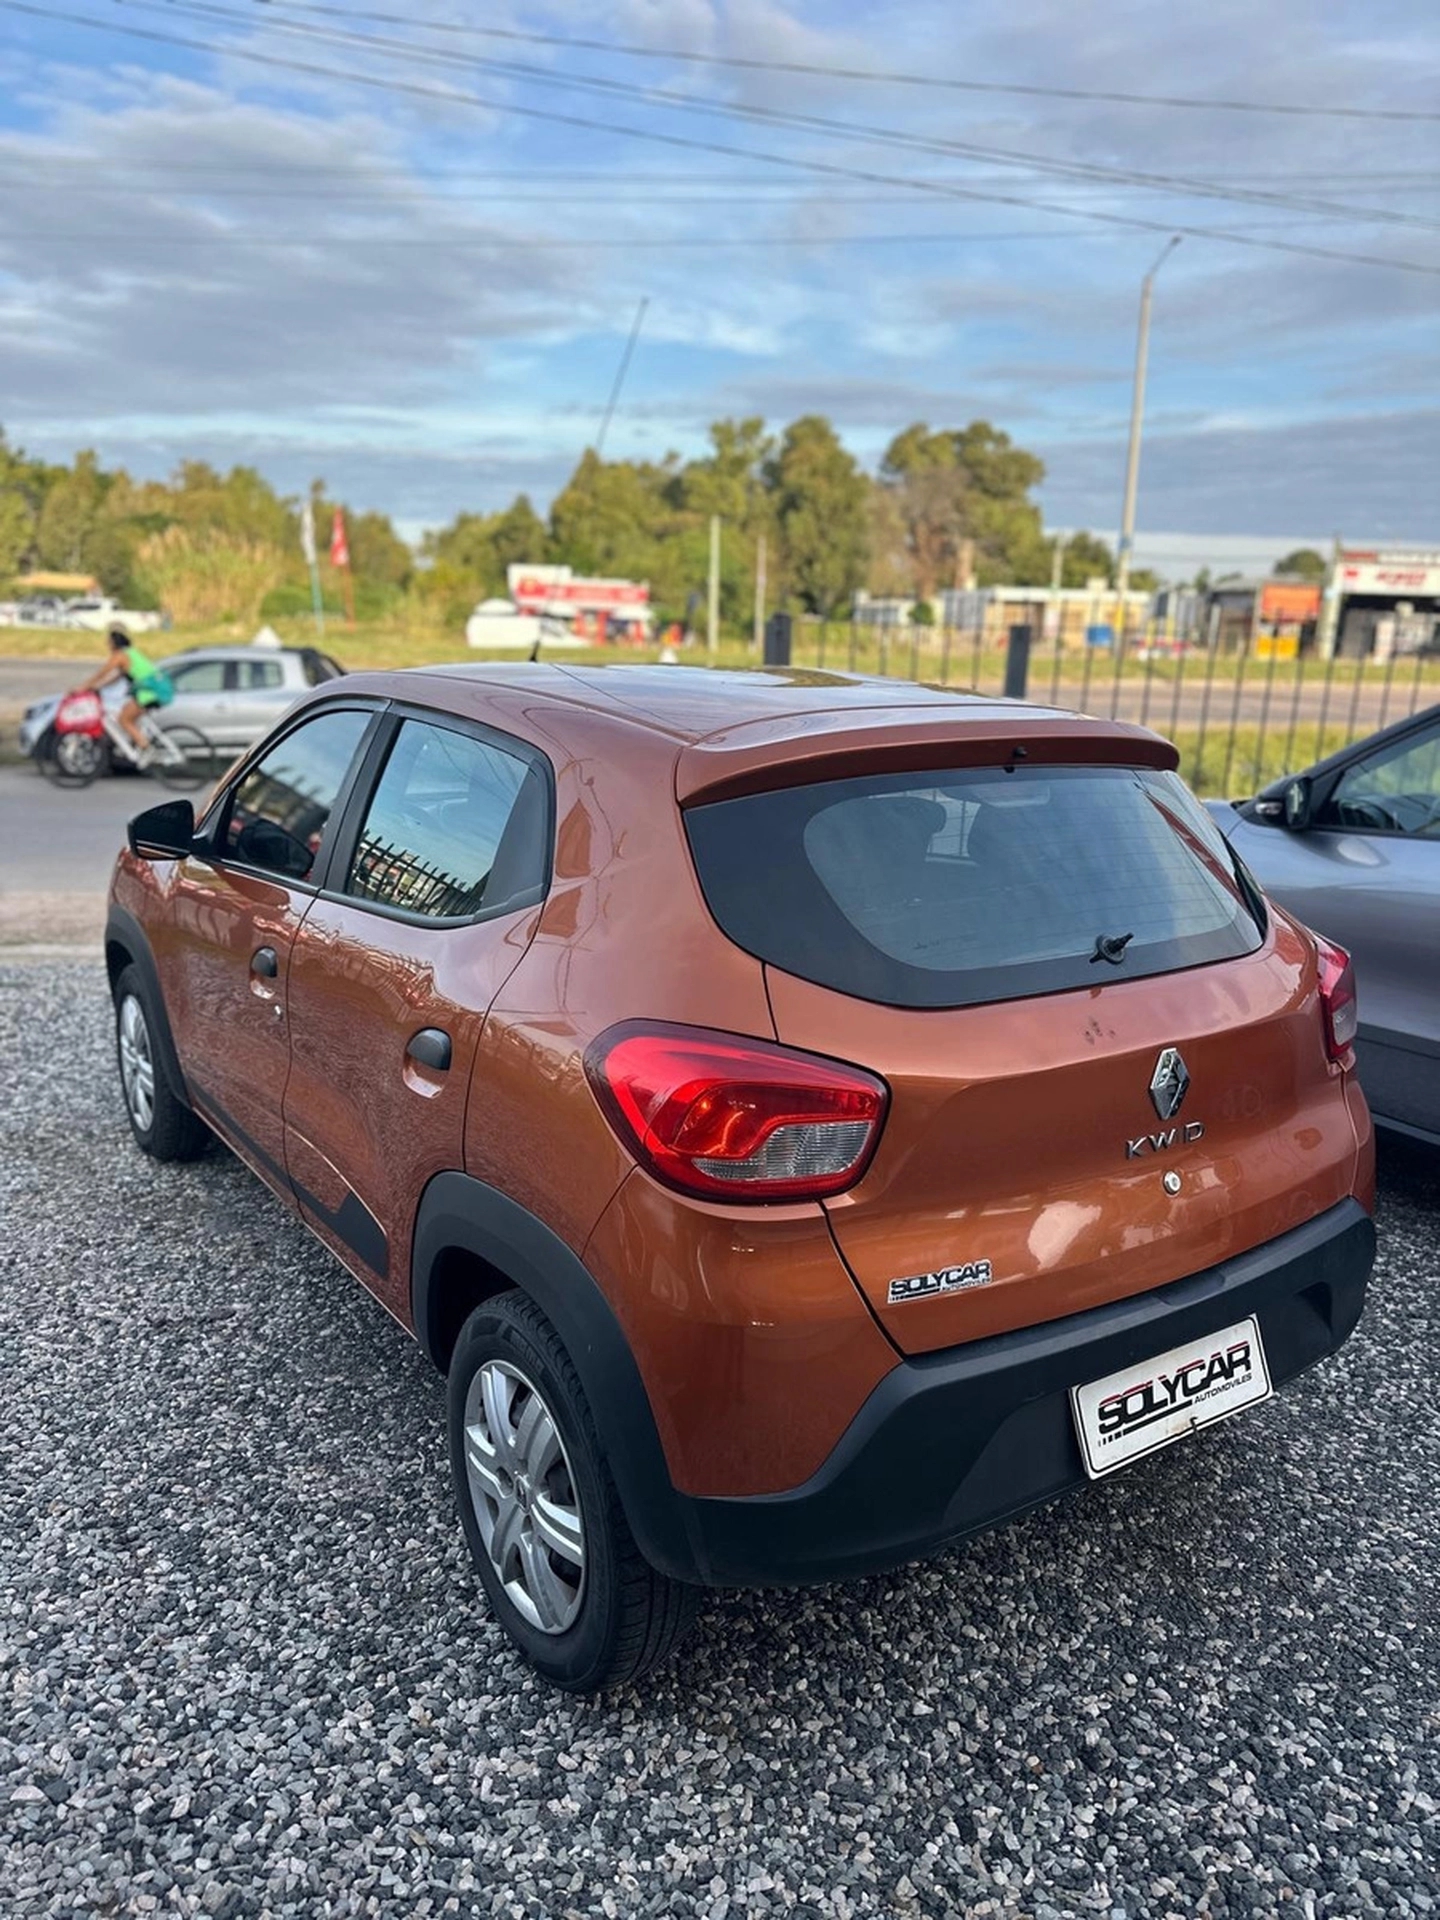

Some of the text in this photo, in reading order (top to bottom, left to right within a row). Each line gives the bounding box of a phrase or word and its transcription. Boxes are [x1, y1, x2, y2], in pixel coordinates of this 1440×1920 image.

[1125, 1121, 1205, 1160] KWID
[890, 1262, 990, 1295] SOLYCAR
[1098, 1341, 1251, 1434] SOLYCAR
[1194, 1373, 1252, 1404] AUTOMOVILES
